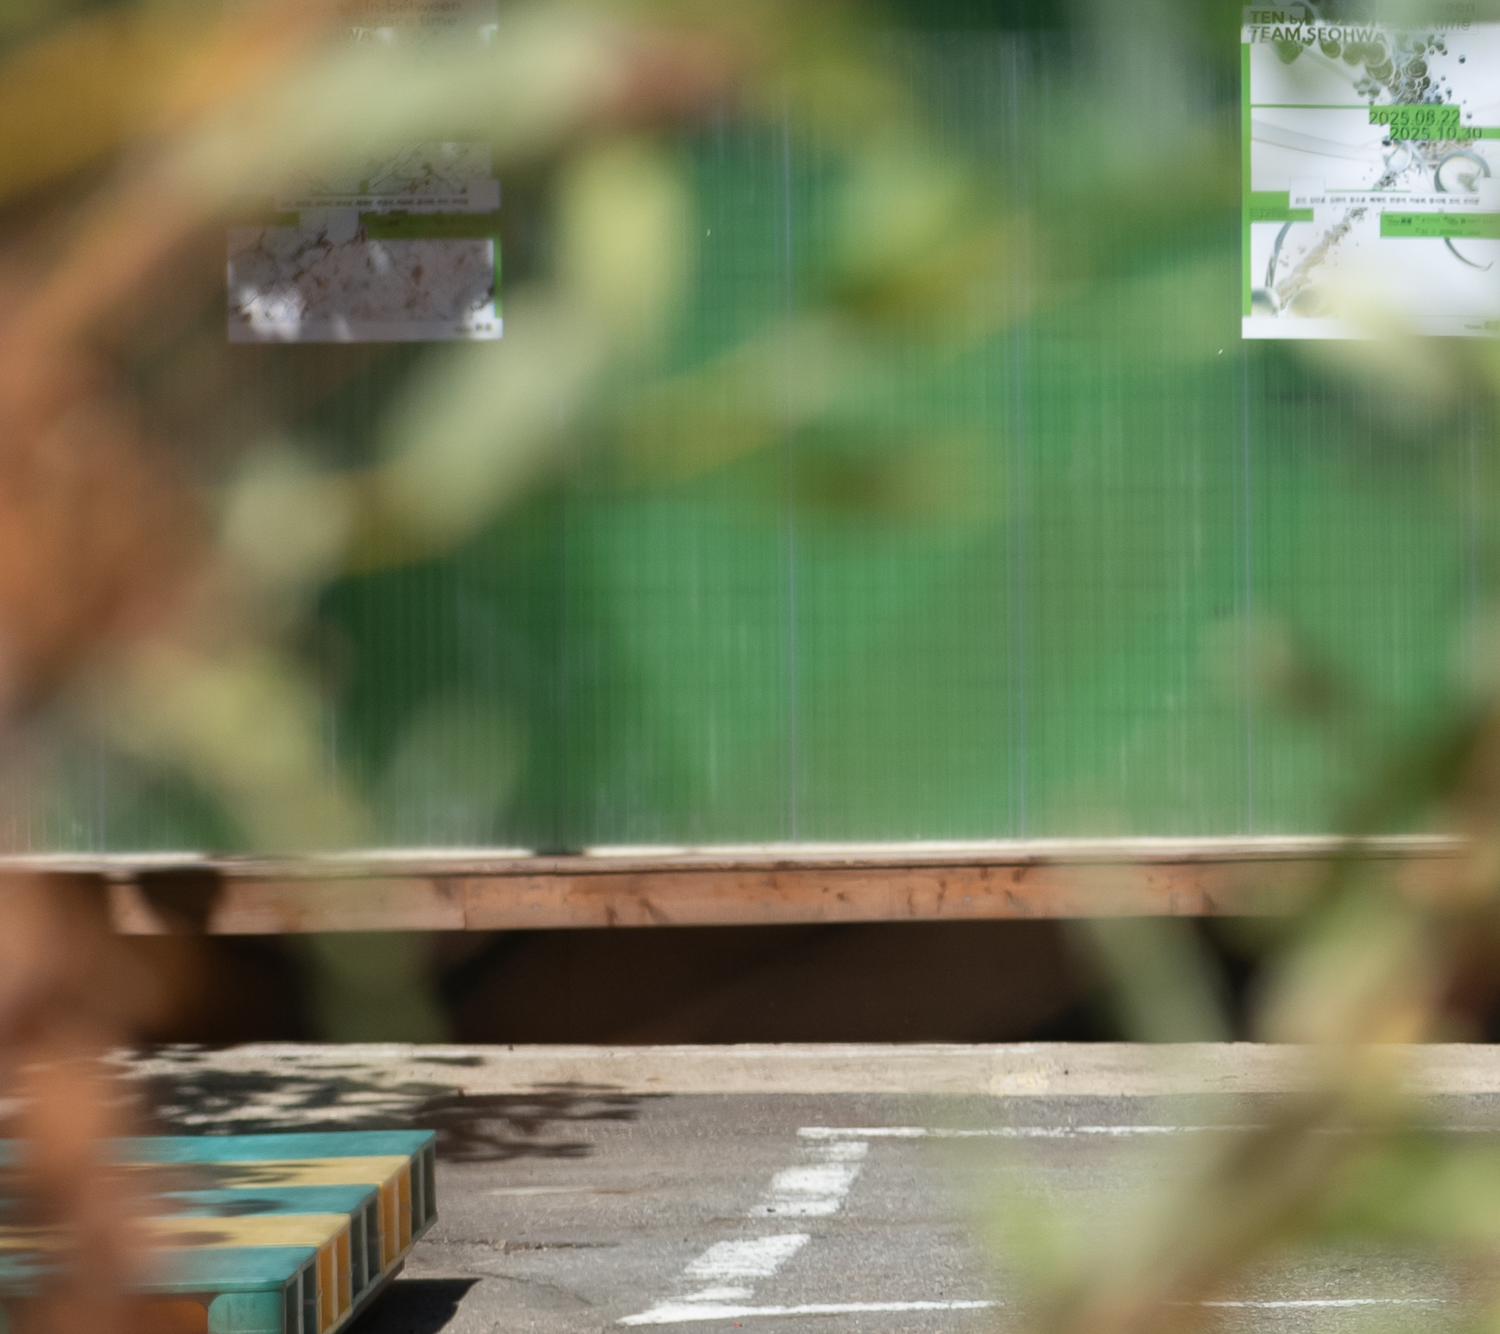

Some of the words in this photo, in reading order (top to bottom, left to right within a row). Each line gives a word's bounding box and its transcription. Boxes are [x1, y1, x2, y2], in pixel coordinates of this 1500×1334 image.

[1251, 10, 1284, 24] TEN
[1290, 11, 1305, 28] by
[1248, 26, 1387, 44] TEAM.SEOHWA
[1369, 109, 1460, 126] 2025.08.22
[1390, 125, 1482, 141] 2025.10.30
